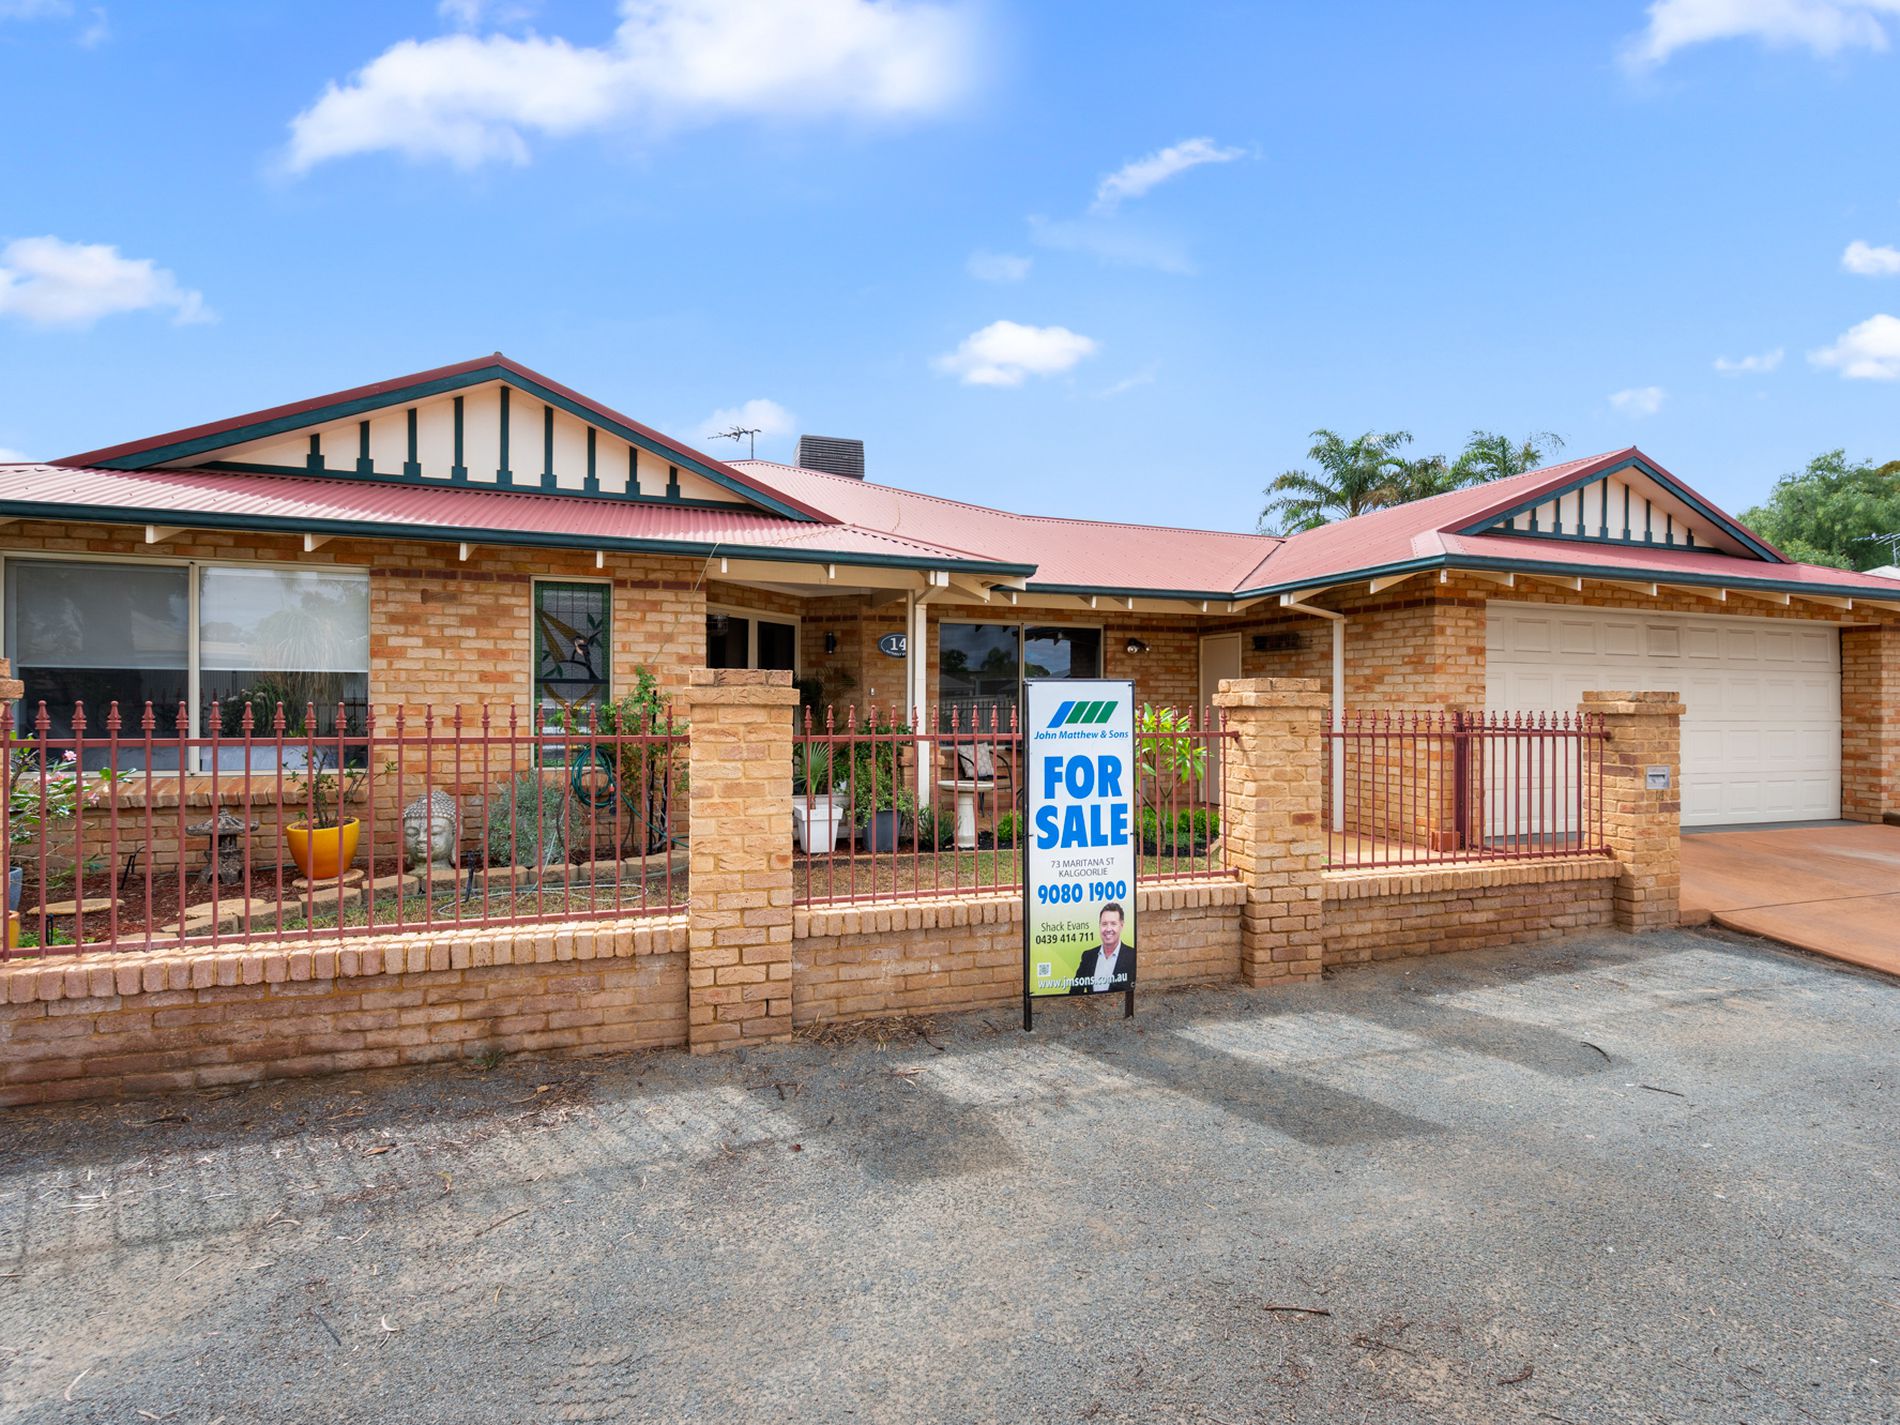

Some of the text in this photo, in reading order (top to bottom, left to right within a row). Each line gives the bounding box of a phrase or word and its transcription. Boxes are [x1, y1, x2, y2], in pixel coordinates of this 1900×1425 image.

[1034, 729, 1129, 740] John Matthew & Sons
[1043, 754, 1123, 800] FOR
[1035, 803, 1128, 850] SALE
[1051, 857, 1115, 869] 73 MARITANA ST
[1058, 867, 1108, 878] KALGOORLIE
[1037, 880, 1127, 905] 9080 1900
[1041, 921, 1090, 932] Shack Evans
[1035, 932, 1094, 945] 0439 414 711
